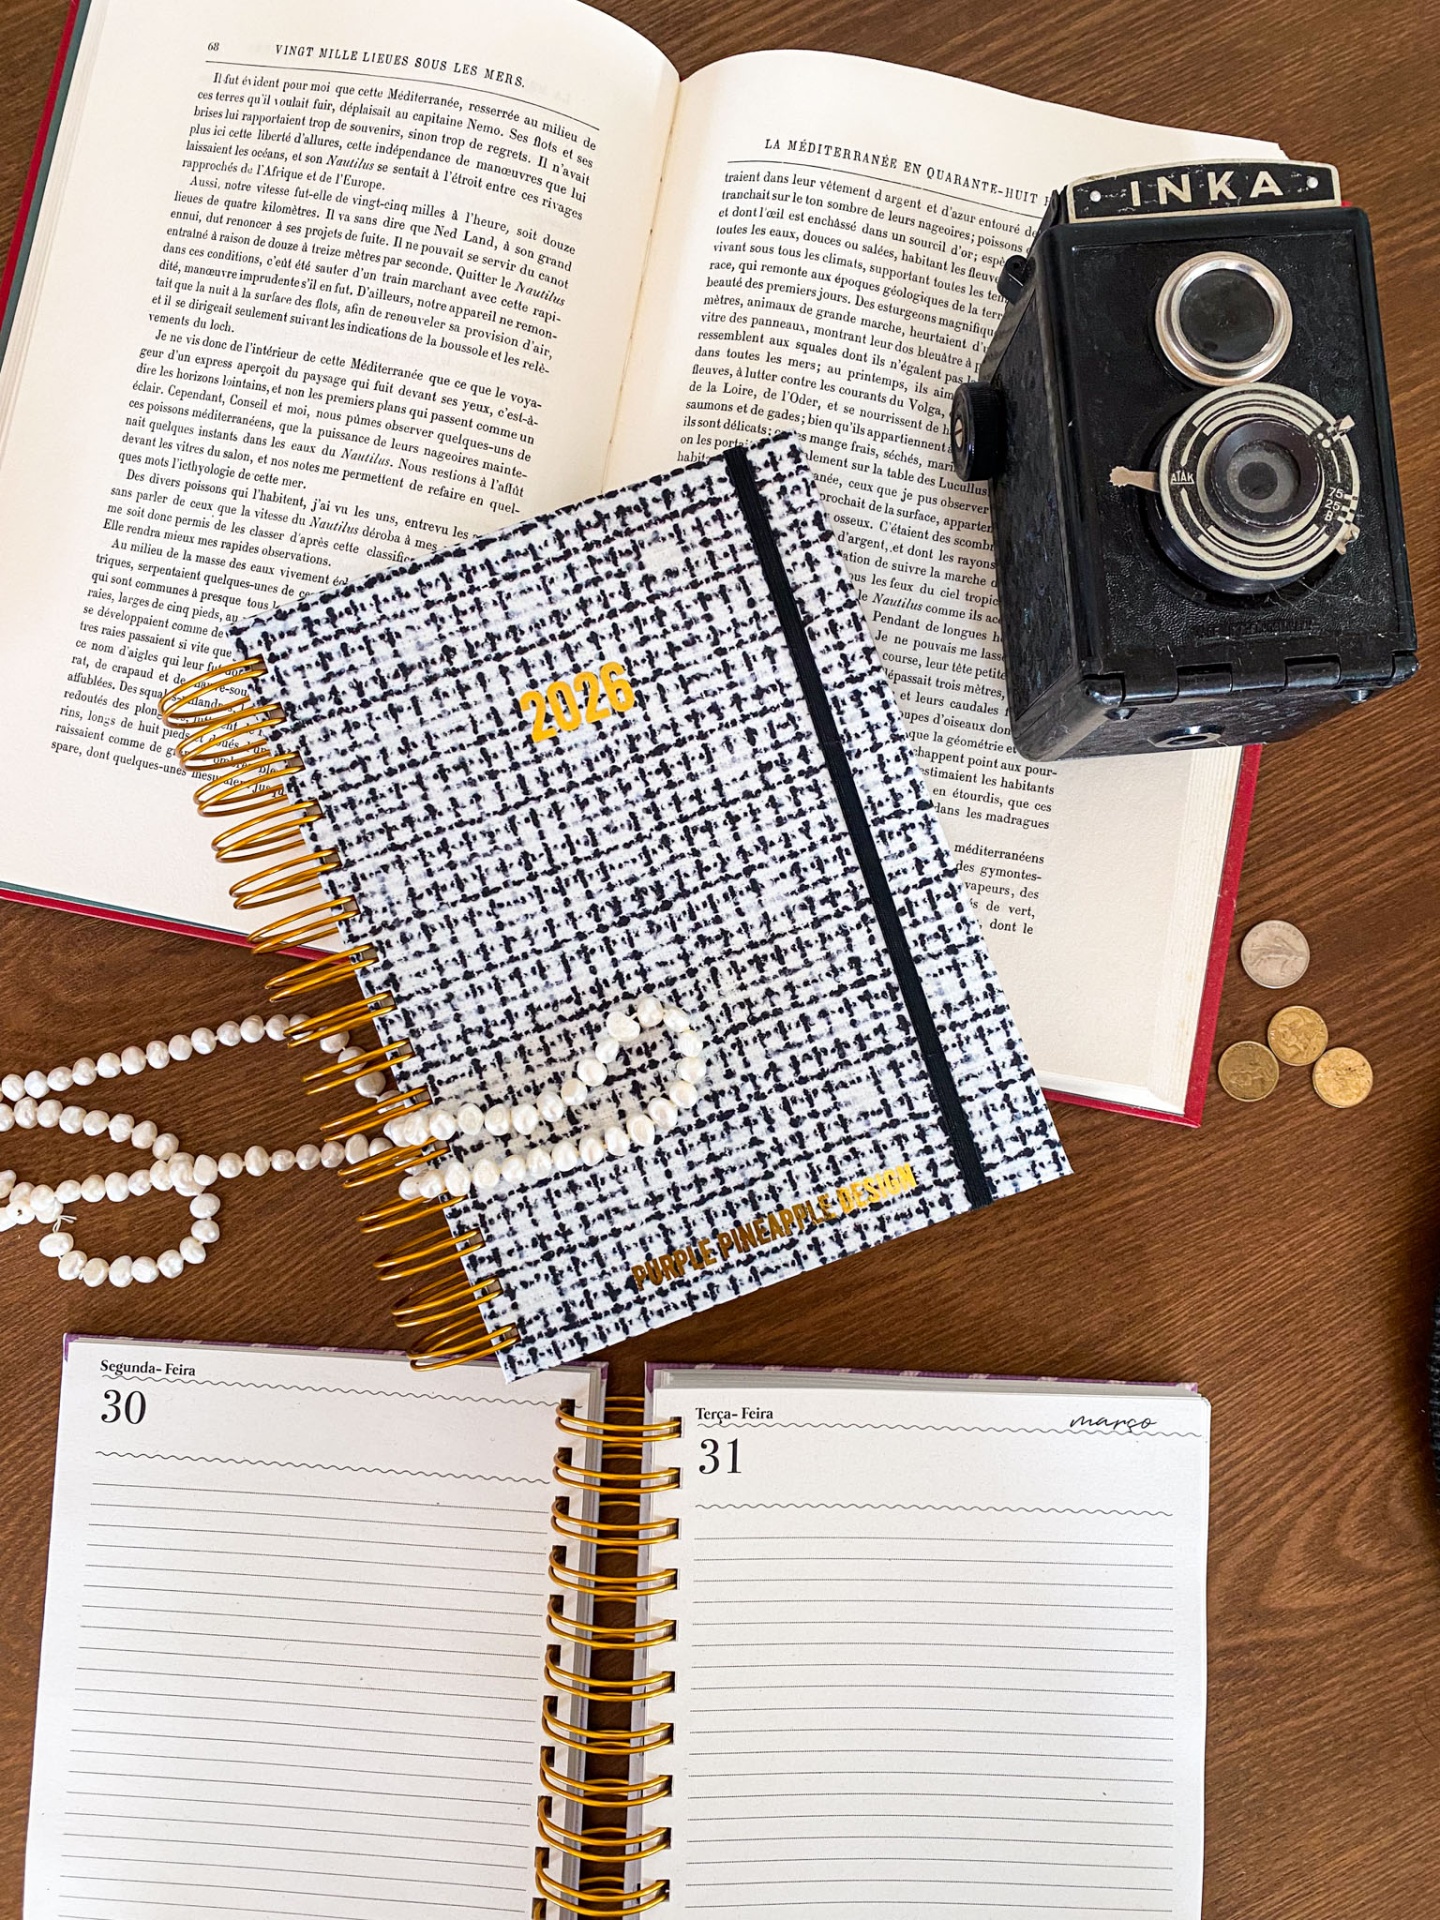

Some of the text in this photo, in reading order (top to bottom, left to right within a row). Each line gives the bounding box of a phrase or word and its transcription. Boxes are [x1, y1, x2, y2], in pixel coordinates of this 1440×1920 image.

[207, 42, 220, 52] 68
[275, 44, 525, 88] VINGT MILLE LIEUES SOUS LES MERS.
[213, 72, 222, 84] Il
[282, 81, 309, 93] pour
[310, 81, 331, 93] moi
[334, 85, 356, 98] que
[357, 87, 384, 99] cette
[468, 103, 520, 122] resserrée
[523, 116, 539, 128] au
[541, 122, 578, 143] milieu
[582, 136, 597, 151] de
[197, 91, 214, 100] ces
[215, 91, 245, 103] terres
[312, 98, 336, 114] fuir,
[339, 100, 391, 118] déplaisait
[394, 110, 409, 120] au
[412, 112, 463, 128] capitaine
[466, 117, 504, 137] Nemo.
[508, 127, 529, 144] Ses
[532, 135, 558, 153] flots
[562, 149, 574, 160] et
[576, 155, 594, 169] ses
[764, 138, 781, 150] LA
[787, 139, 898, 169] MÉDITERRANÉE
[903, 161, 922, 175] EN
[926, 167, 1038, 205] QUARANTE-HUIT
[1130, 170, 1284, 207] INKA
[724, 170, 1021, 235] traient dans leur vêtement et d'azur entouré
[716, 223, 966, 276] toutes les eaux, douces ou salées, habitant les
[154, 328, 542, 409] Je ne vis donc de l'intérieur de cette Méditerranée que ce que le voya-
[697, 329, 964, 384] ressemblent aux squales dont ils n'égalent pas
[132, 380, 532, 463] éclair. Cependant, Conseil et moi, nous pûmes observer quelques-uns de
[1170, 470, 1195, 484] ATAK
[1329, 486, 1344, 499] 75
[848, 480, 990, 515] ceux que je pus observer
[1324, 499, 1341, 511] 25
[102, 517, 332, 567] Elle rendra mieux mes rapides observations.
[95, 553, 295, 597] triques, serpentaient quelques-unes de
[82, 605, 224, 639] se développaient comme de
[857, 588, 983, 622] le Nautilus comme ils
[871, 609, 988, 641] Pendant de longues
[874, 629, 978, 658] Je ne pouvais me
[881, 652, 973, 675] course, leur tête
[520, 661, 636, 743] 2026
[50, 741, 187, 777] spare, dont quelques-unes
[966, 756, 1058, 777] point aux pour-
[932, 787, 1052, 813] en étourdis, que ces
[965, 806, 1050, 830] les madragues
[953, 843, 1045, 865] méditerranéens
[955, 859, 1042, 882] des gymontes-
[964, 881, 1040, 900] vapeurs, des
[985, 899, 1035, 920] de vert,
[989, 917, 1034, 935] dont le
[631, 1162, 919, 1291] PURPLE PINEAPPLE DESIGN
[165, 1362, 196, 1376] Feira
[101, 1389, 146, 1425] 30
[741, 1407, 774, 1420] Feira
[1070, 1415, 1157, 1434] março
[698, 1438, 742, 1475] 31
